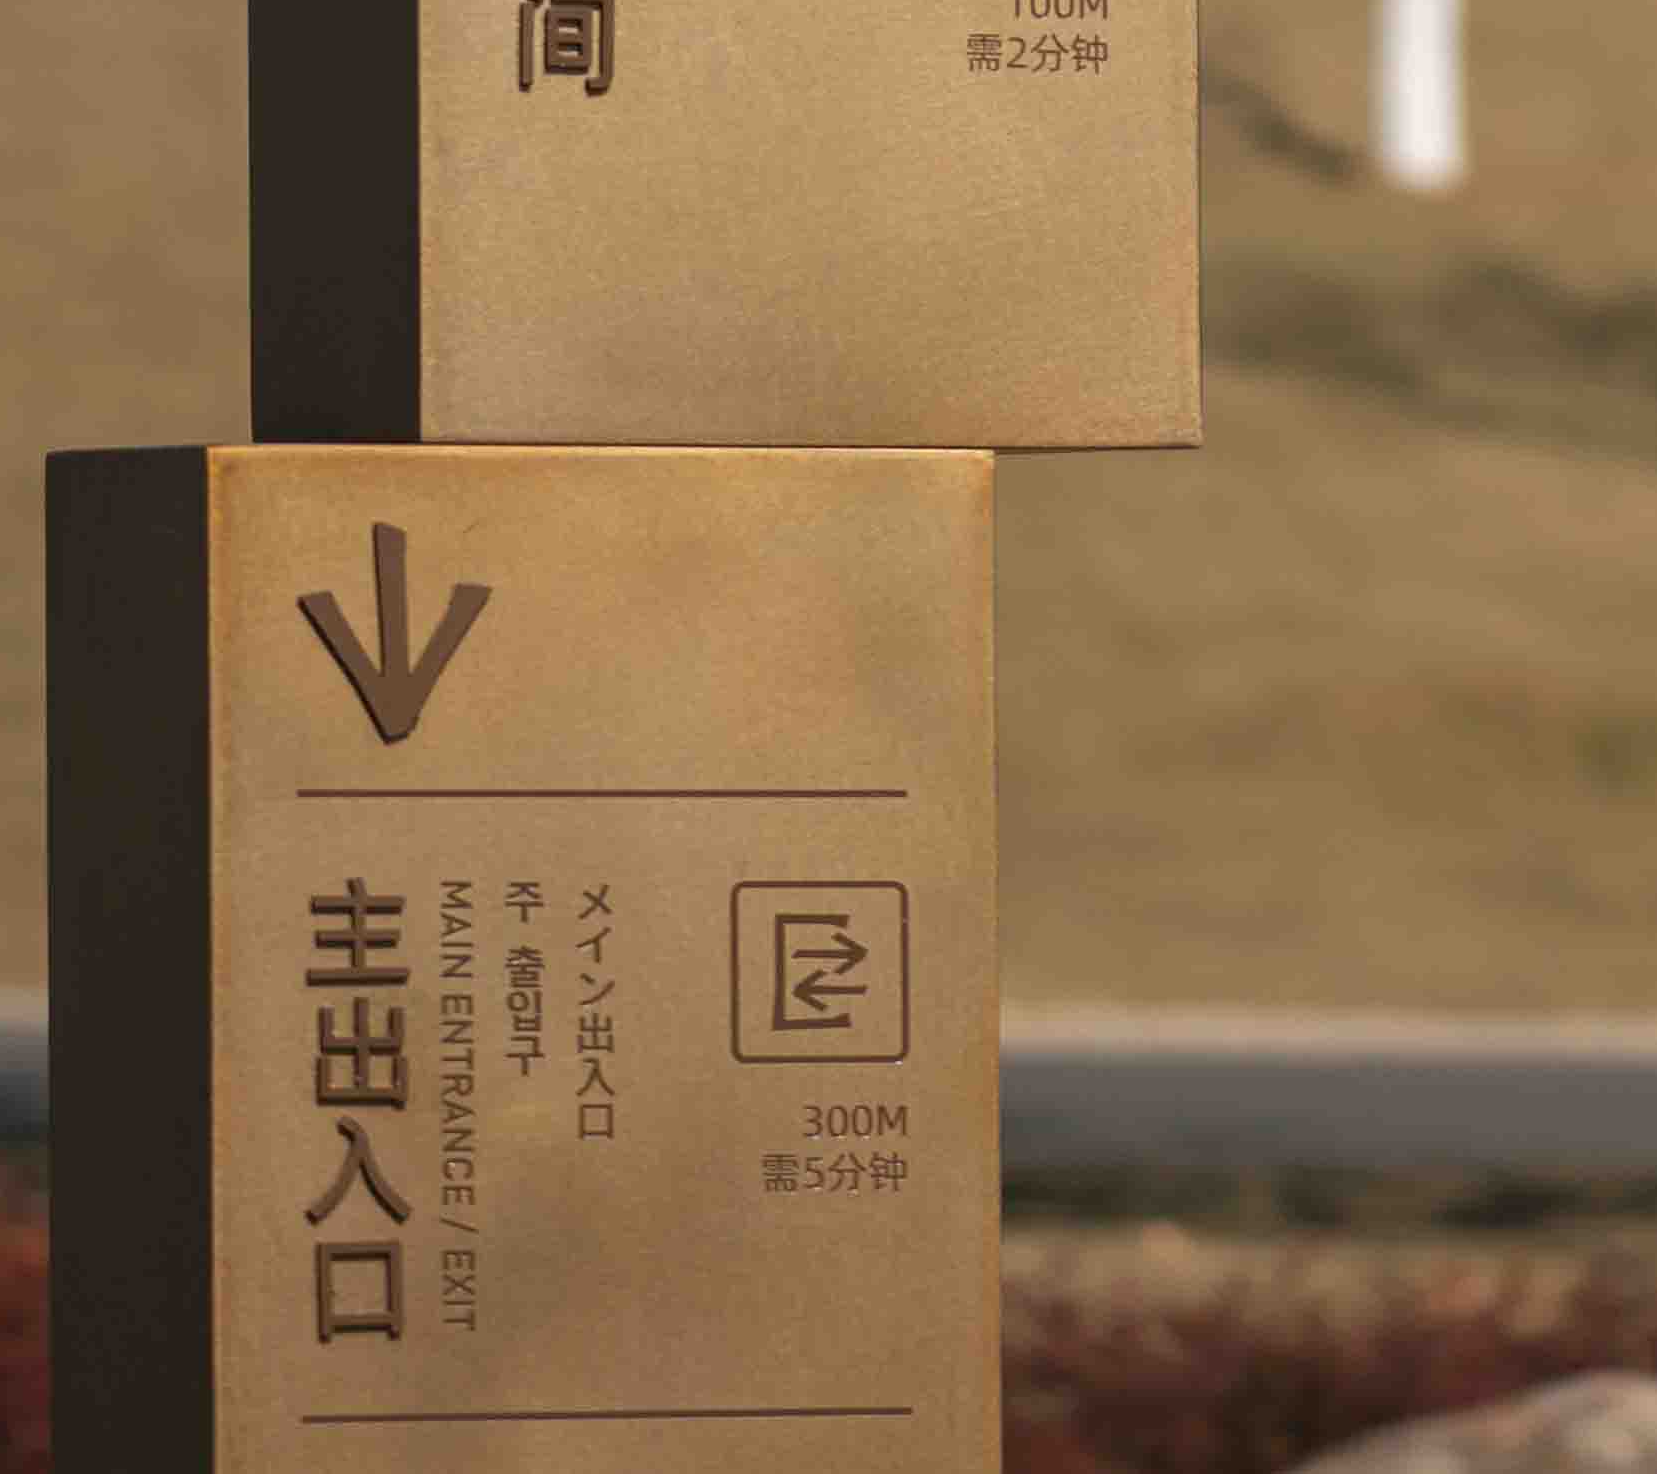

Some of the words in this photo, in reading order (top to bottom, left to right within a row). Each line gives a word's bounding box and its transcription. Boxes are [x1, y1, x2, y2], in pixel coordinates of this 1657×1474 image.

[967, 33, 1108, 75] 需2分钟
[439, 881, 474, 978] MAIN
[505, 882, 544, 923] 주
[505, 945, 545, 1077] 출입구
[575, 885, 615, 1139] メイン出入口
[303, 877, 411, 1345] 主出入口
[440, 995, 474, 1205] ENTRANCE
[803, 1105, 908, 1137] 300M
[762, 1152, 907, 1191] 需5分钟
[441, 1219, 479, 1233] /
[443, 1250, 475, 1331] EXIT
